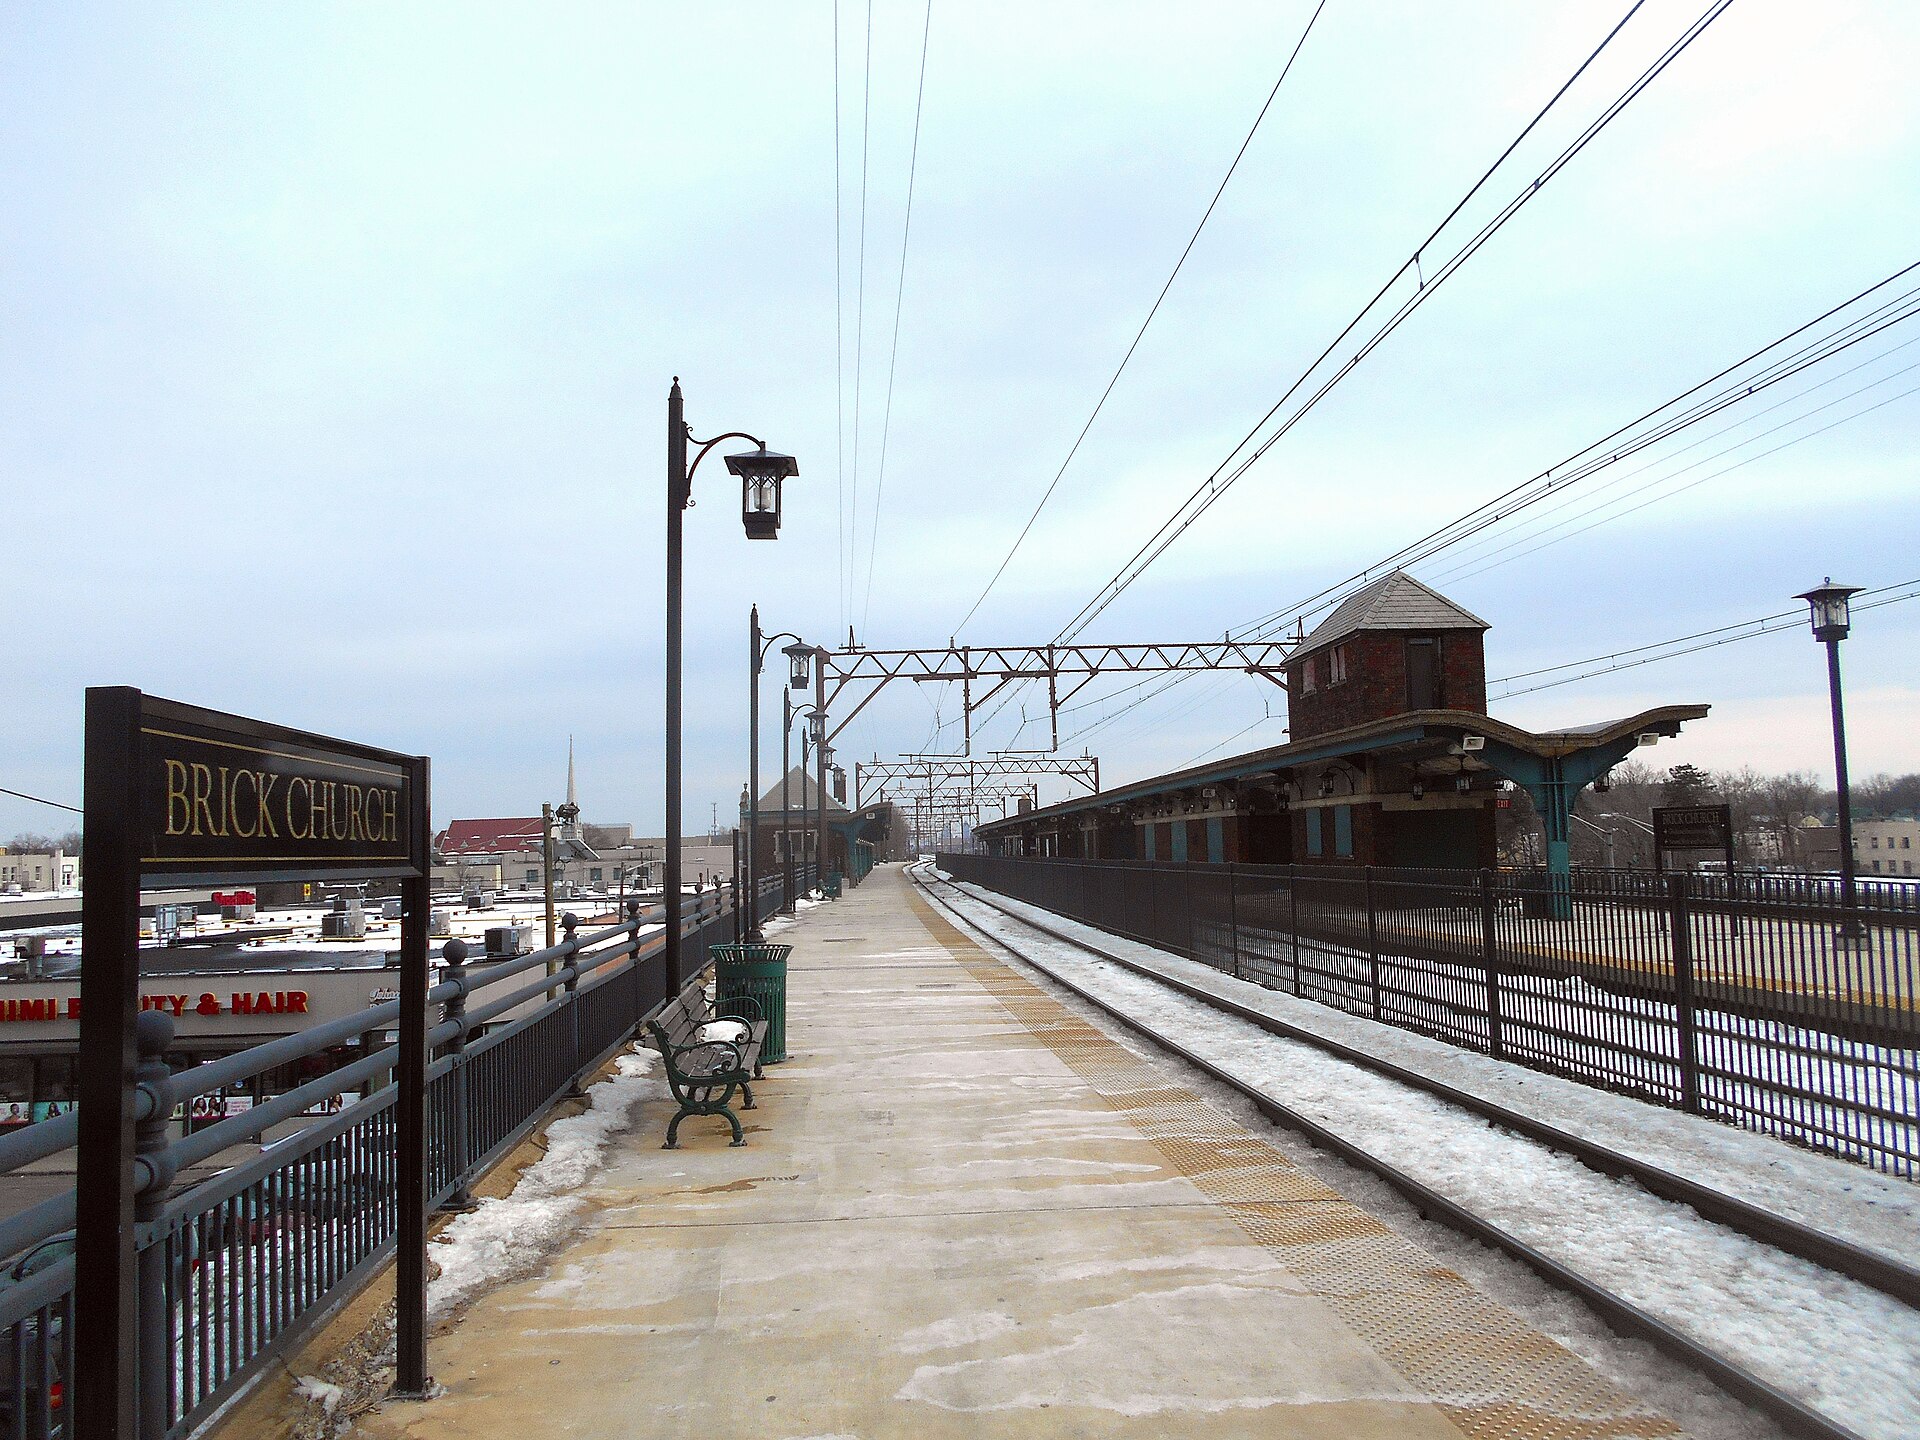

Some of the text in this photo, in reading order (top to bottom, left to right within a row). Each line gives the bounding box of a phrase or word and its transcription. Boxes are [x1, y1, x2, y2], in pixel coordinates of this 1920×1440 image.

[164, 758, 398, 843] BRICK CHURCH
[0, 997, 58, 1022] IMI
[196, 991, 221, 1015] &
[231, 989, 309, 1015] HAIR
